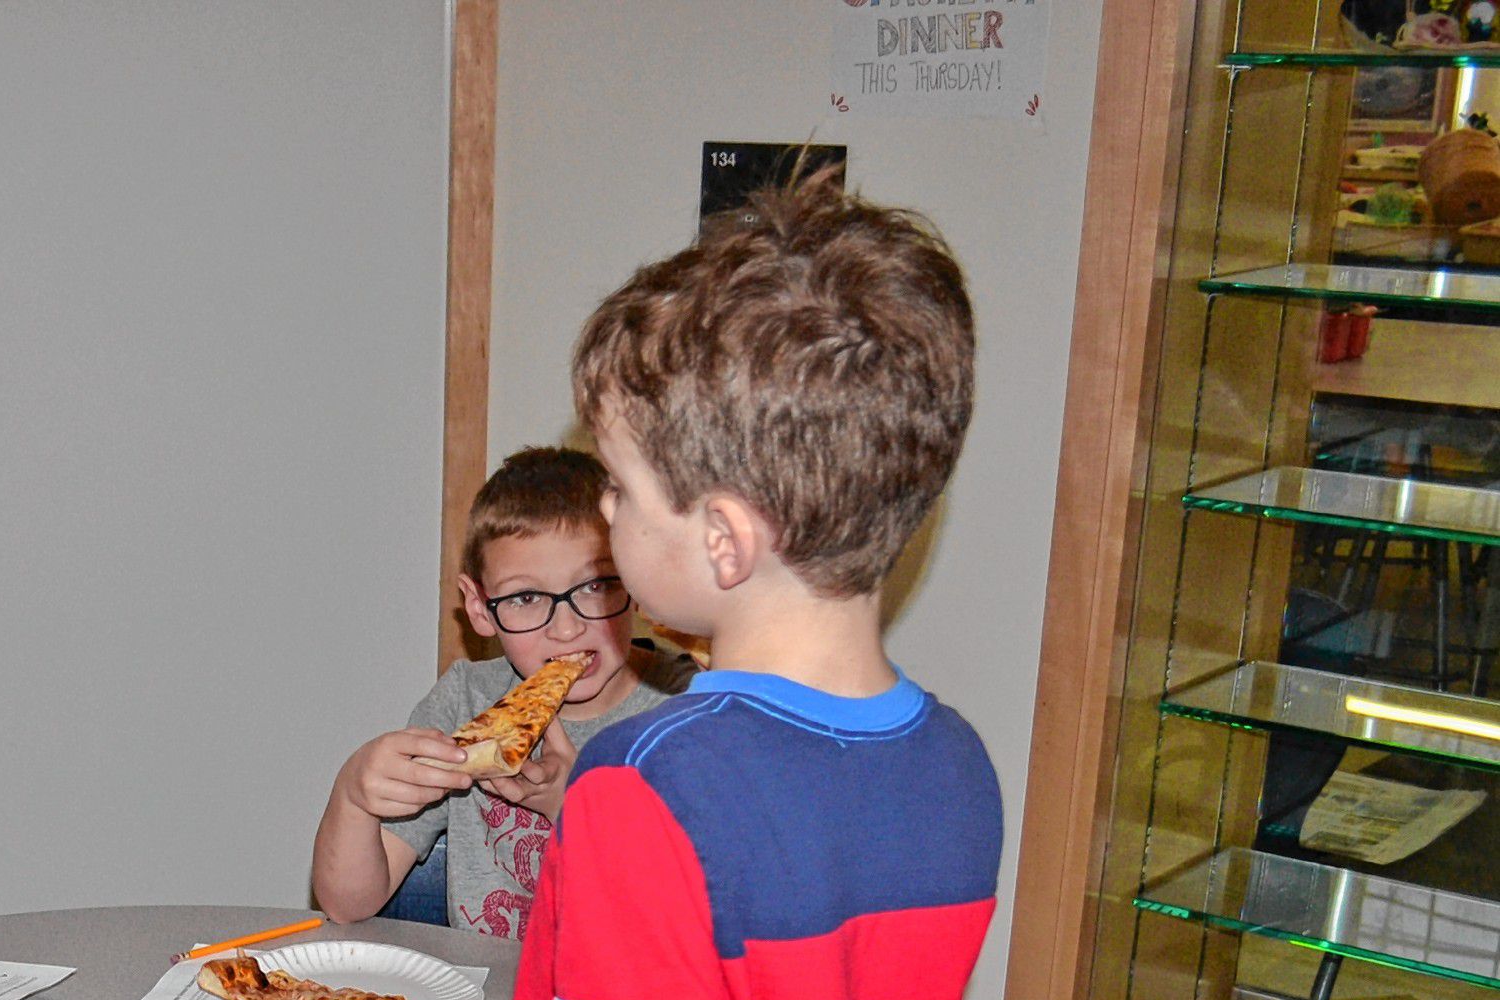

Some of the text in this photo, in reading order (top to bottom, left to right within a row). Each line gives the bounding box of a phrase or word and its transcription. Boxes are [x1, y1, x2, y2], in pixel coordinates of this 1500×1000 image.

[877, 10, 1004, 57] DINNER
[855, 61, 898, 94] THIS
[710, 151, 737, 168] 134
